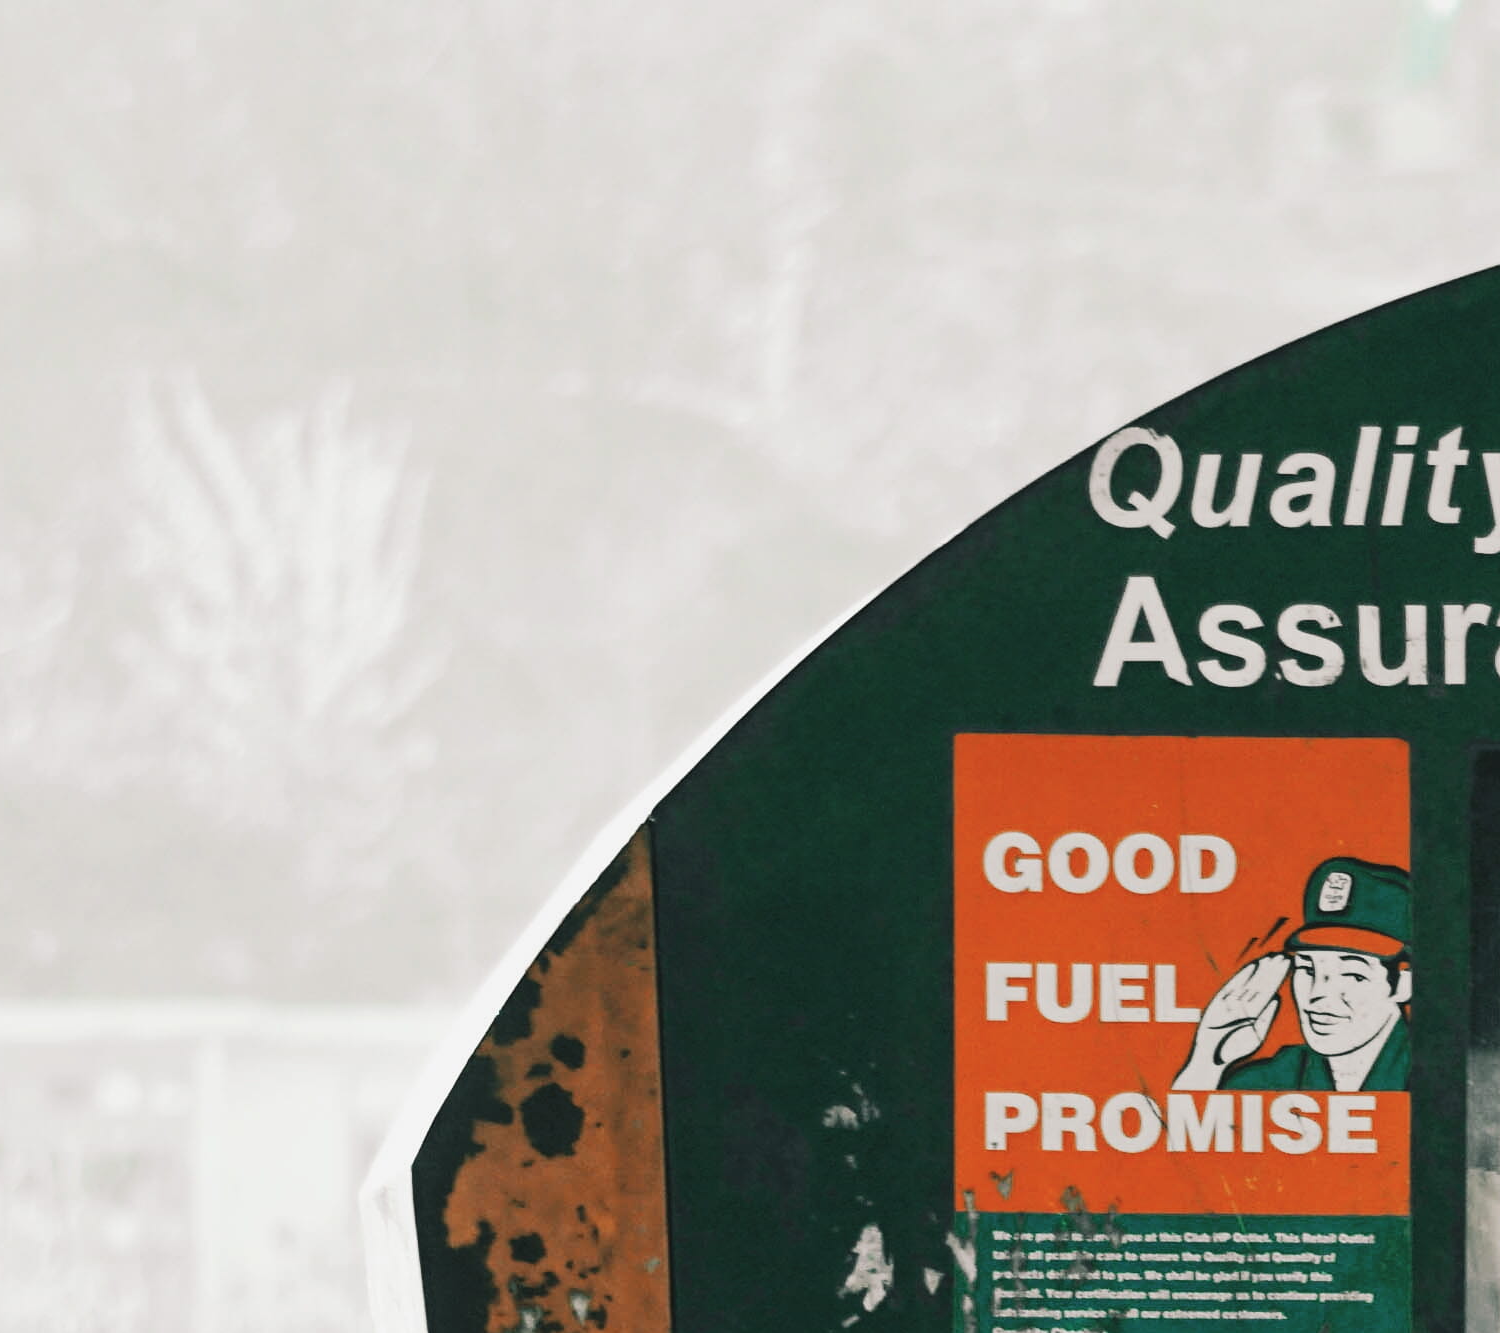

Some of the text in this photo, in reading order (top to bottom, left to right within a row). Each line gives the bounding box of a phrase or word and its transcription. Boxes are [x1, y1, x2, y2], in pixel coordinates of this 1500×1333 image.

[982, 831, 1238, 896] GOOD
[985, 962, 1201, 1023] FUEL
[984, 1091, 1380, 1155] PROMISE
